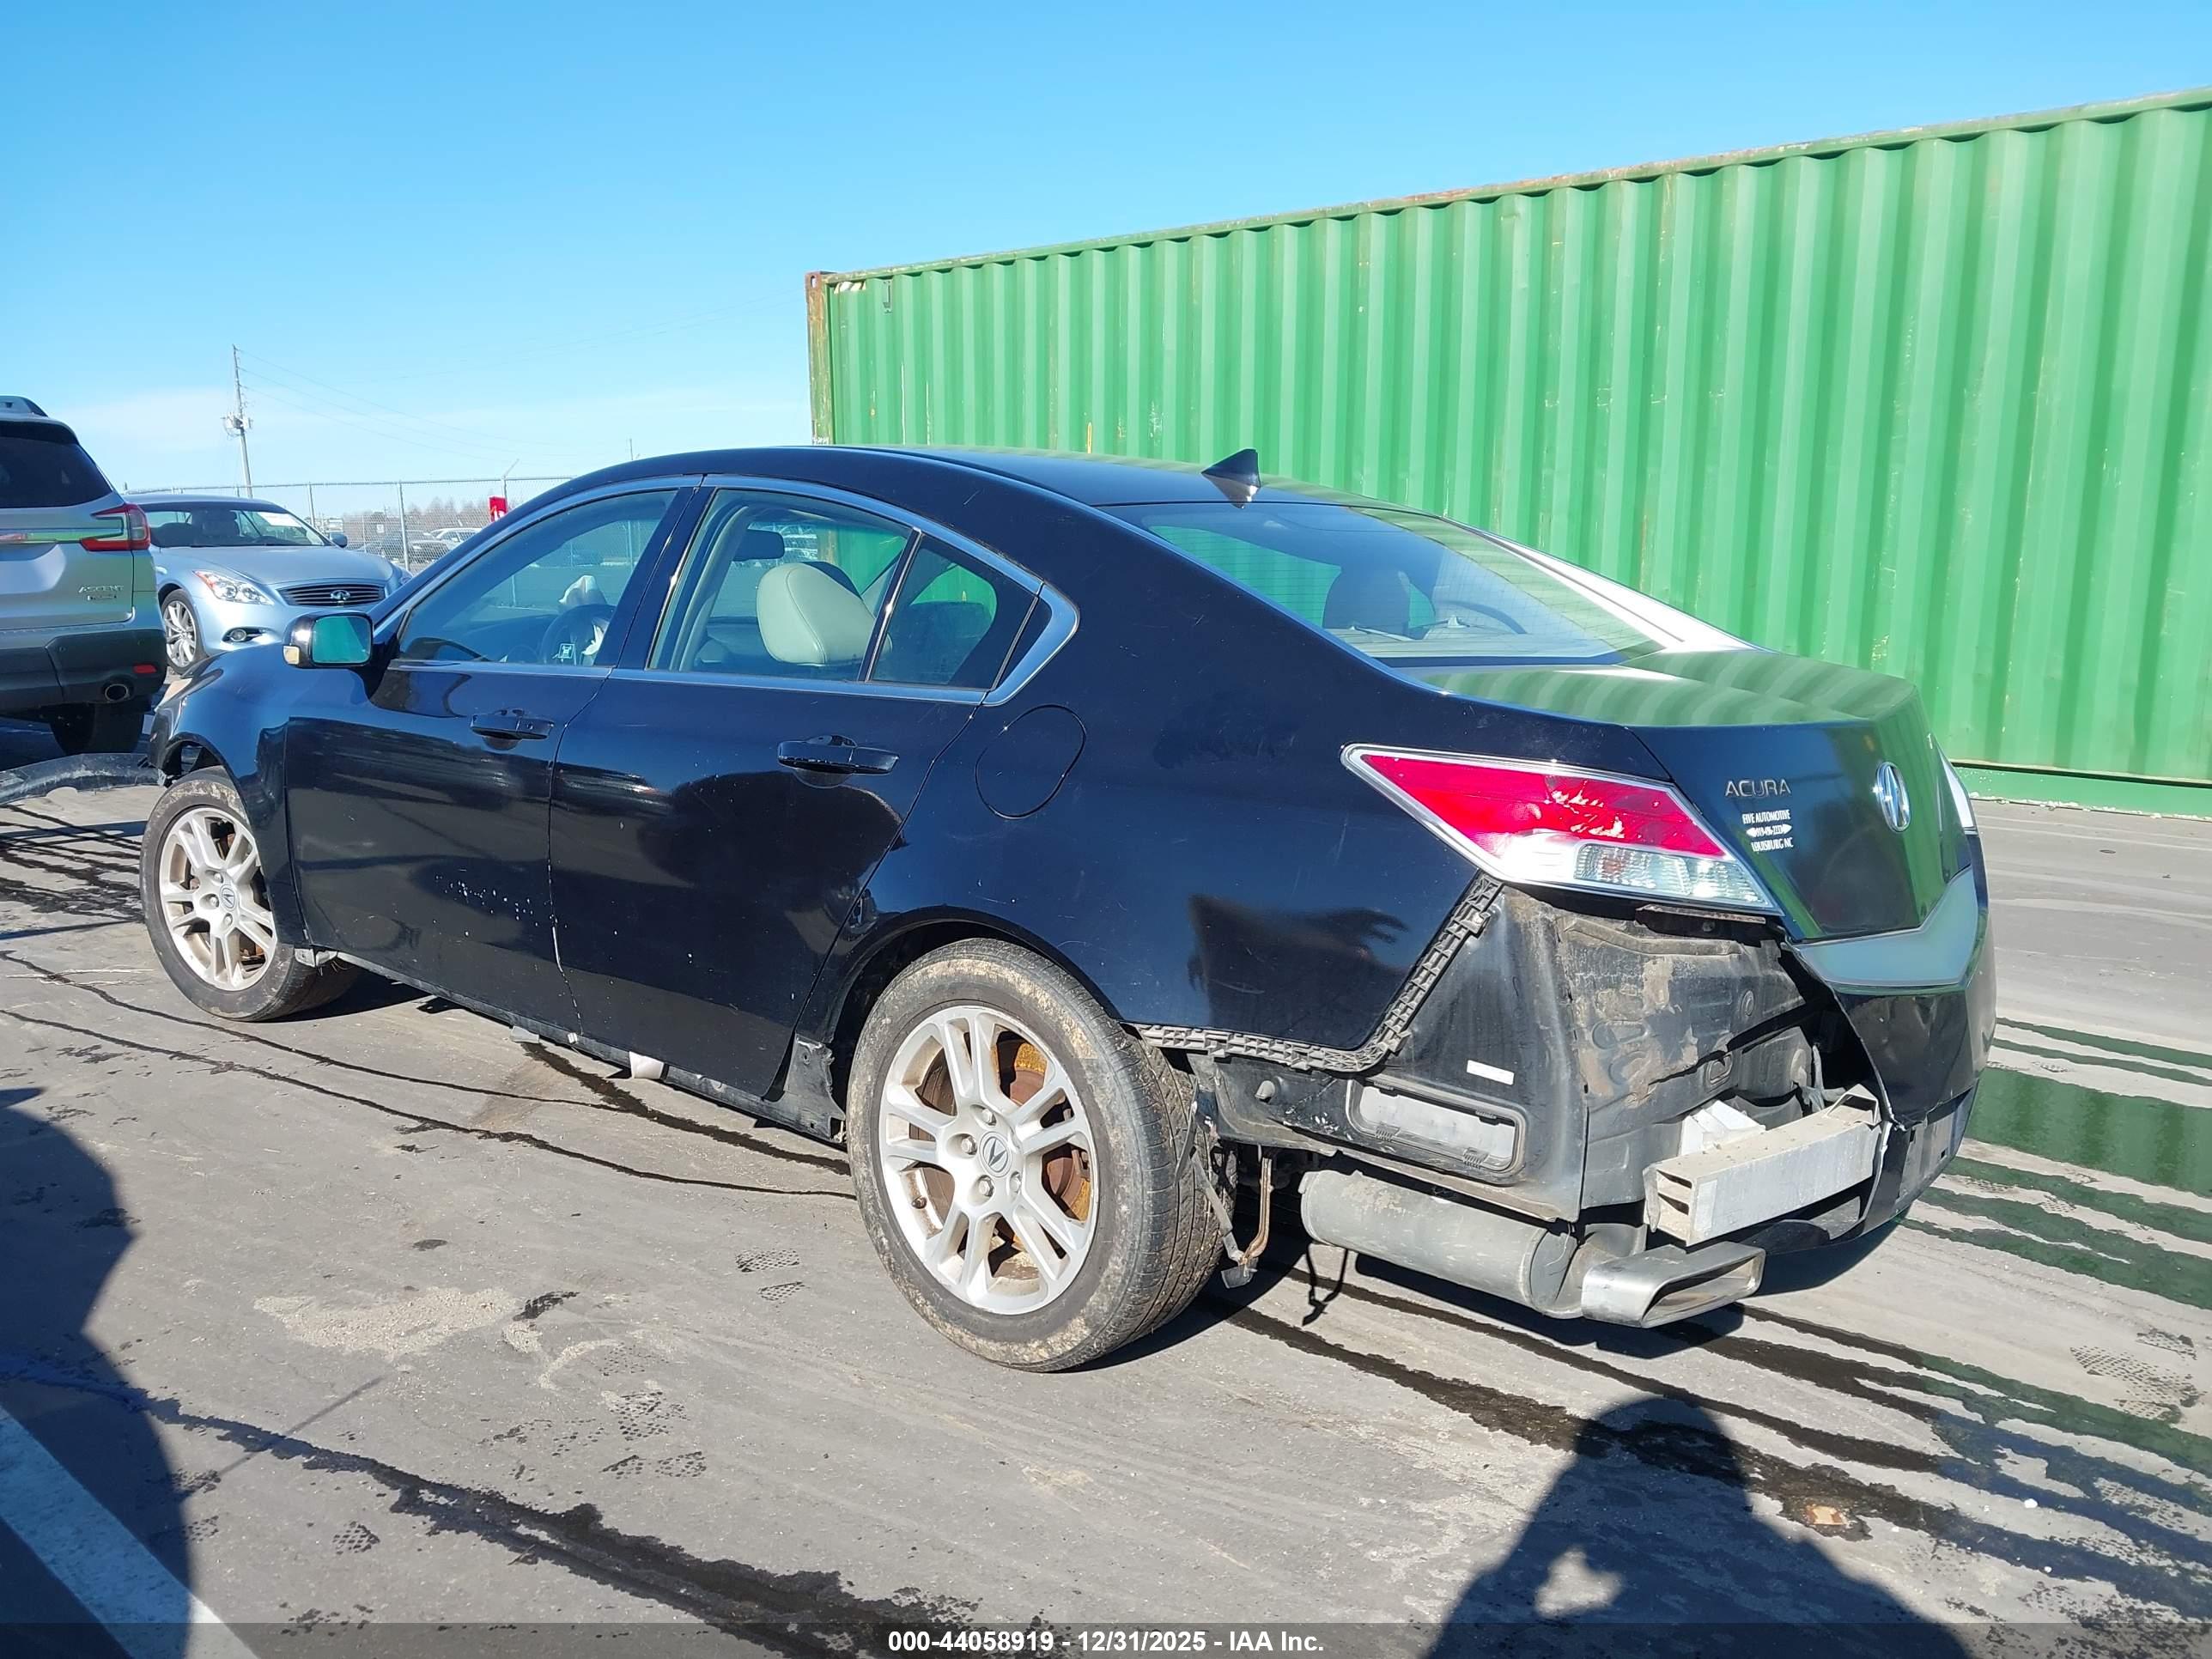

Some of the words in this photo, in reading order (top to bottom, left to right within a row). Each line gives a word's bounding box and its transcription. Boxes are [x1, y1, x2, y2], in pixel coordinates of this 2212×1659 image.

[1725, 779, 1792, 797] ACURA
[1755, 809, 1791, 823] AUTOMOTIVE
[1784, 837, 1794, 848] NC
